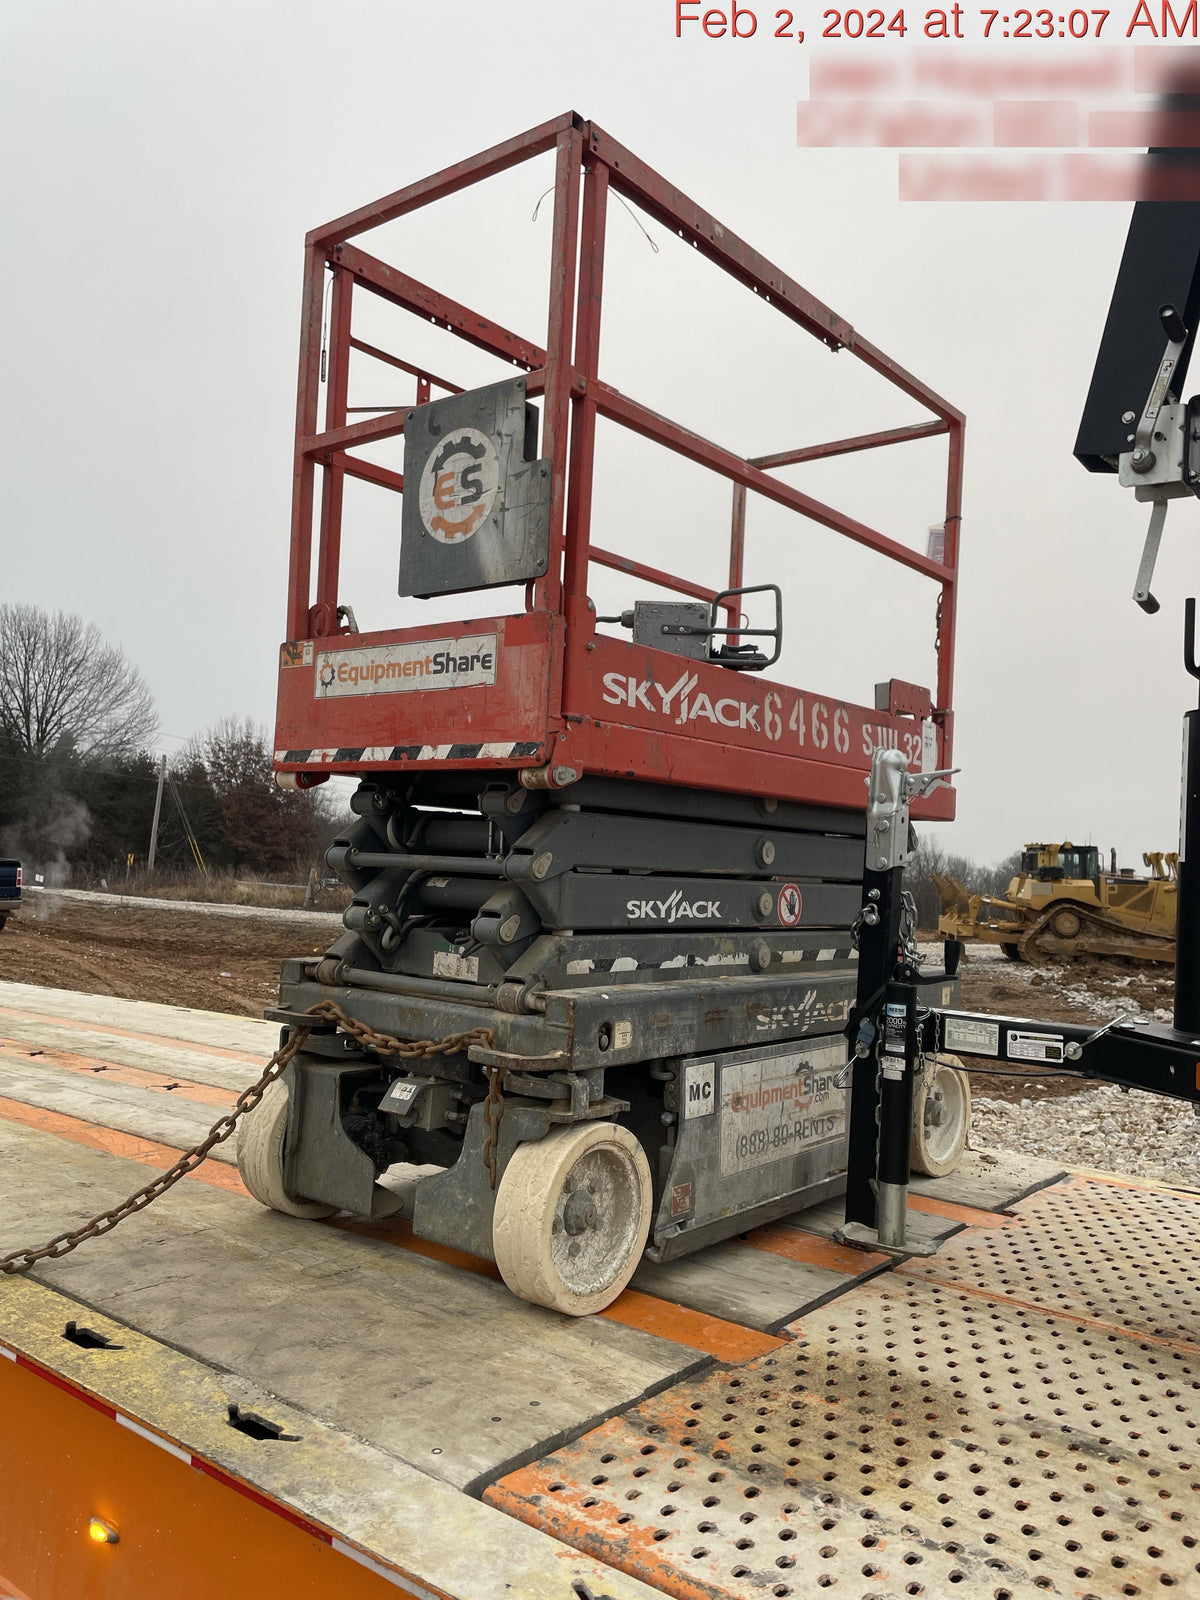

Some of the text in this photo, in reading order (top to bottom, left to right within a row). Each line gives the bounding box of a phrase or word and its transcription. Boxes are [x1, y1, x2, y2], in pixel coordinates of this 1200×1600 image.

[337, 652, 492, 686] EquipmentShare
[602, 670, 761, 732] SKYJACK
[764, 692, 850, 754] 6466
[626, 889, 722, 924] SKYJACK
[689, 1082, 712, 1102] MC
[731, 1074, 841, 1114] EquipmentShar
